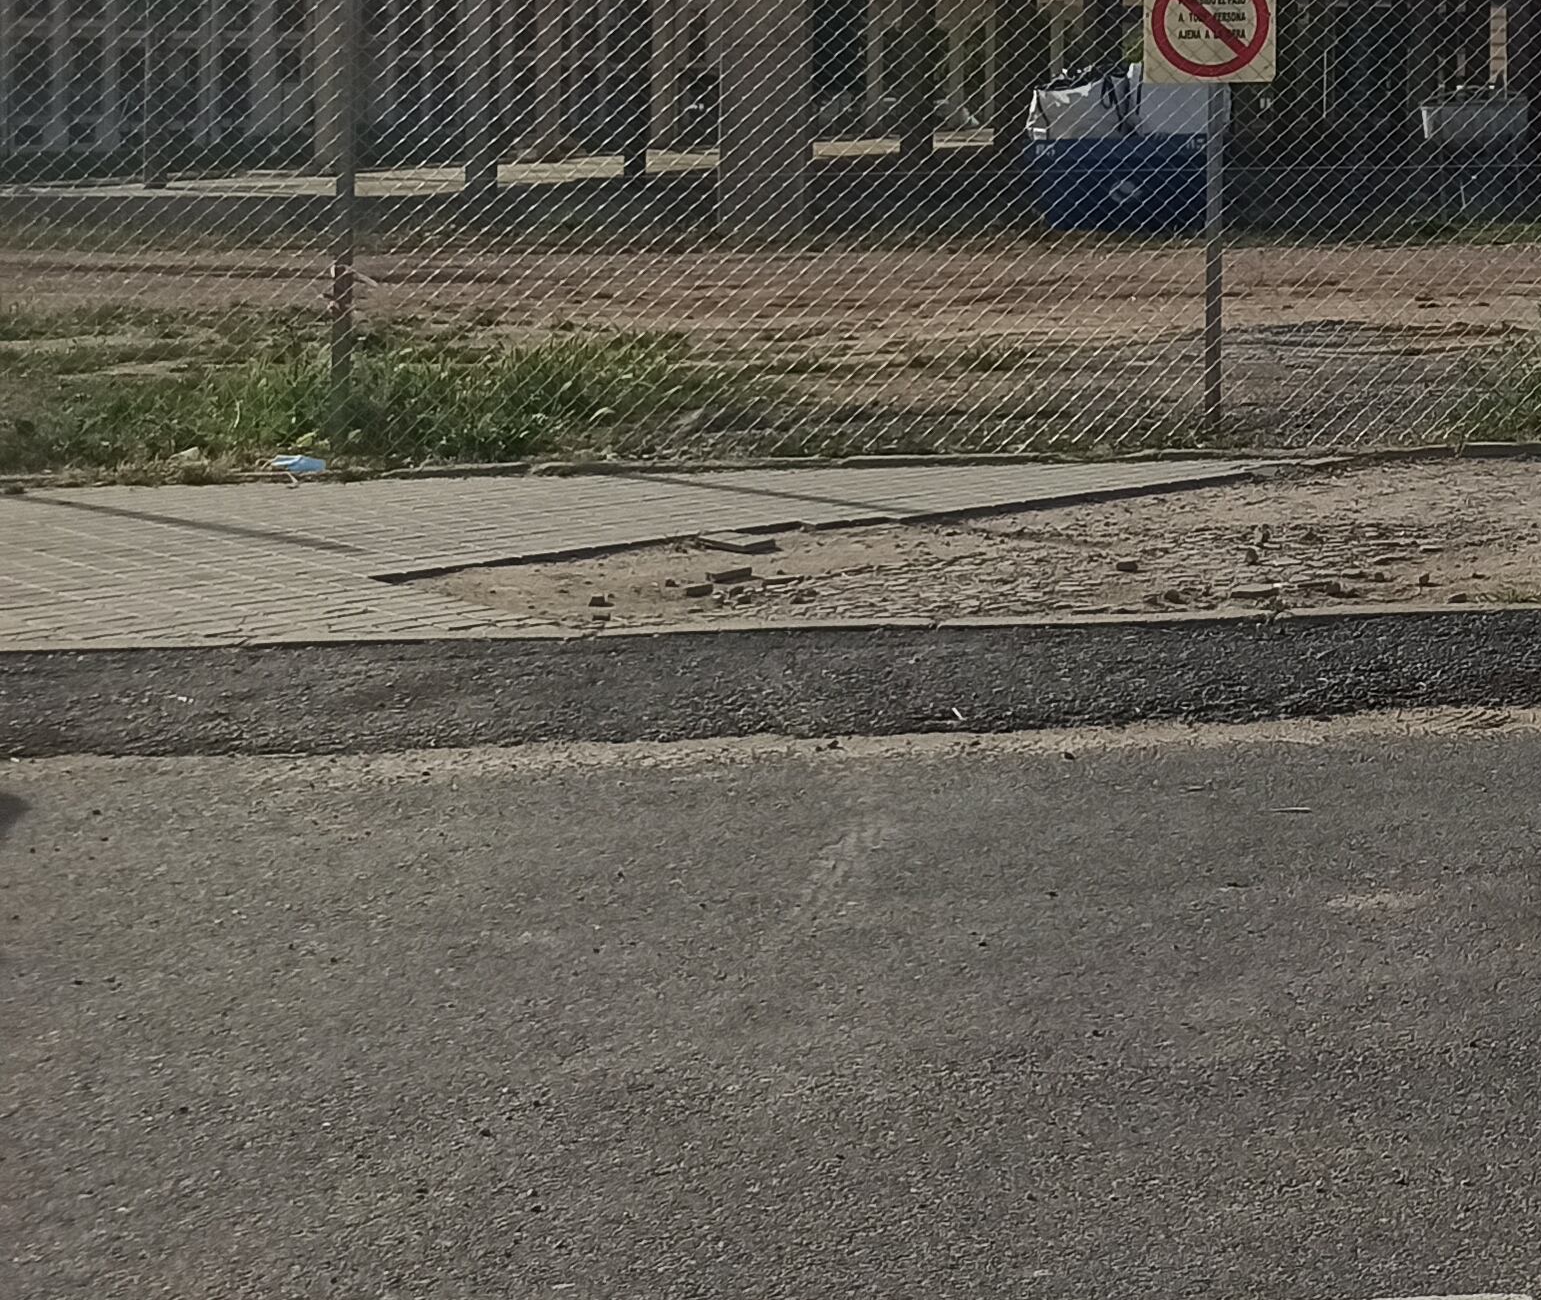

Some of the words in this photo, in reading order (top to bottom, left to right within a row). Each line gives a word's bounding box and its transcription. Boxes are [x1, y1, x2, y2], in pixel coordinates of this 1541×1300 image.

[1178, 12, 1184, 22] A
[1178, 30, 1201, 39] AJENA
[1205, 30, 1210, 39] A
